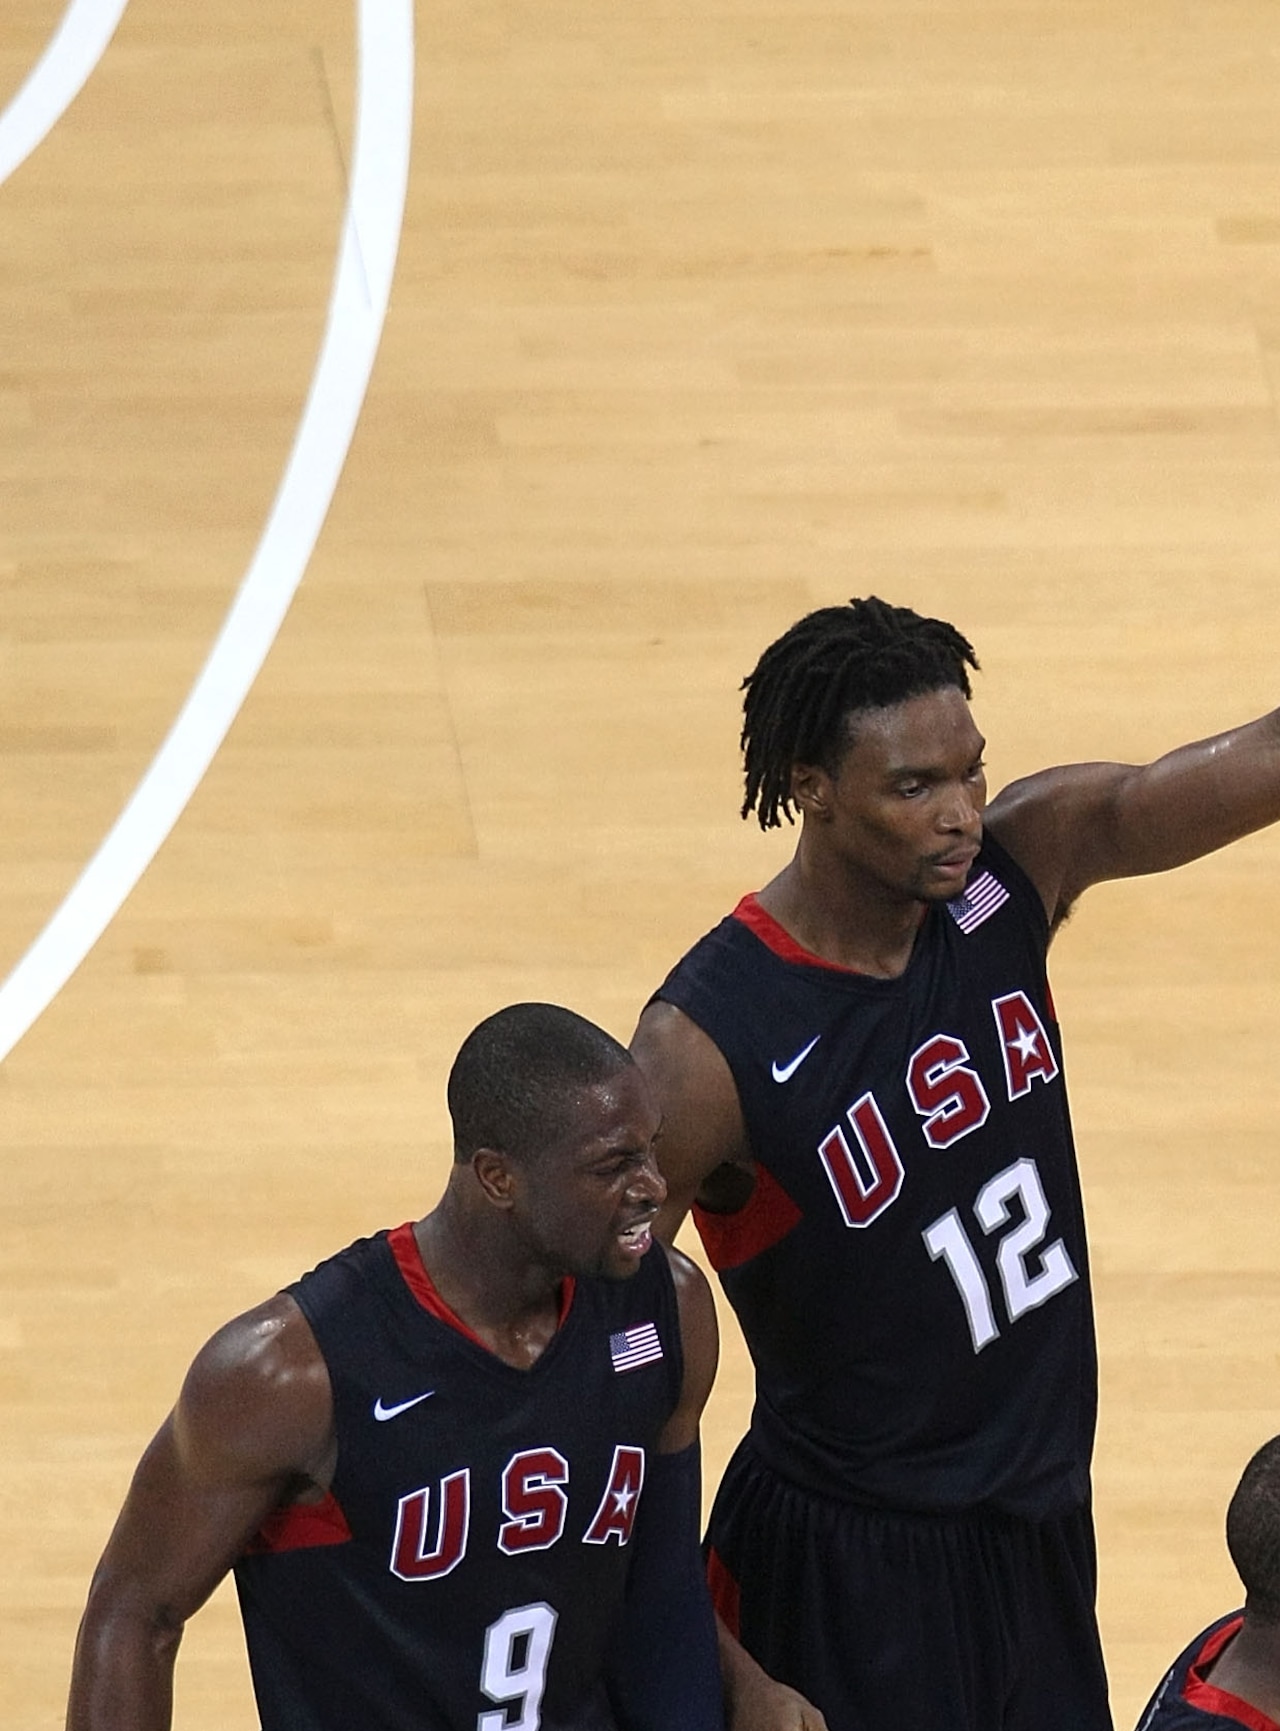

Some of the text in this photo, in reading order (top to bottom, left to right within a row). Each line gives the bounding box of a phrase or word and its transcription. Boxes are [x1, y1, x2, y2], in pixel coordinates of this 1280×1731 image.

[817, 989, 1060, 1229] USA
[921, 1157, 1080, 1355] 12
[389, 1444, 646, 1582] USA
